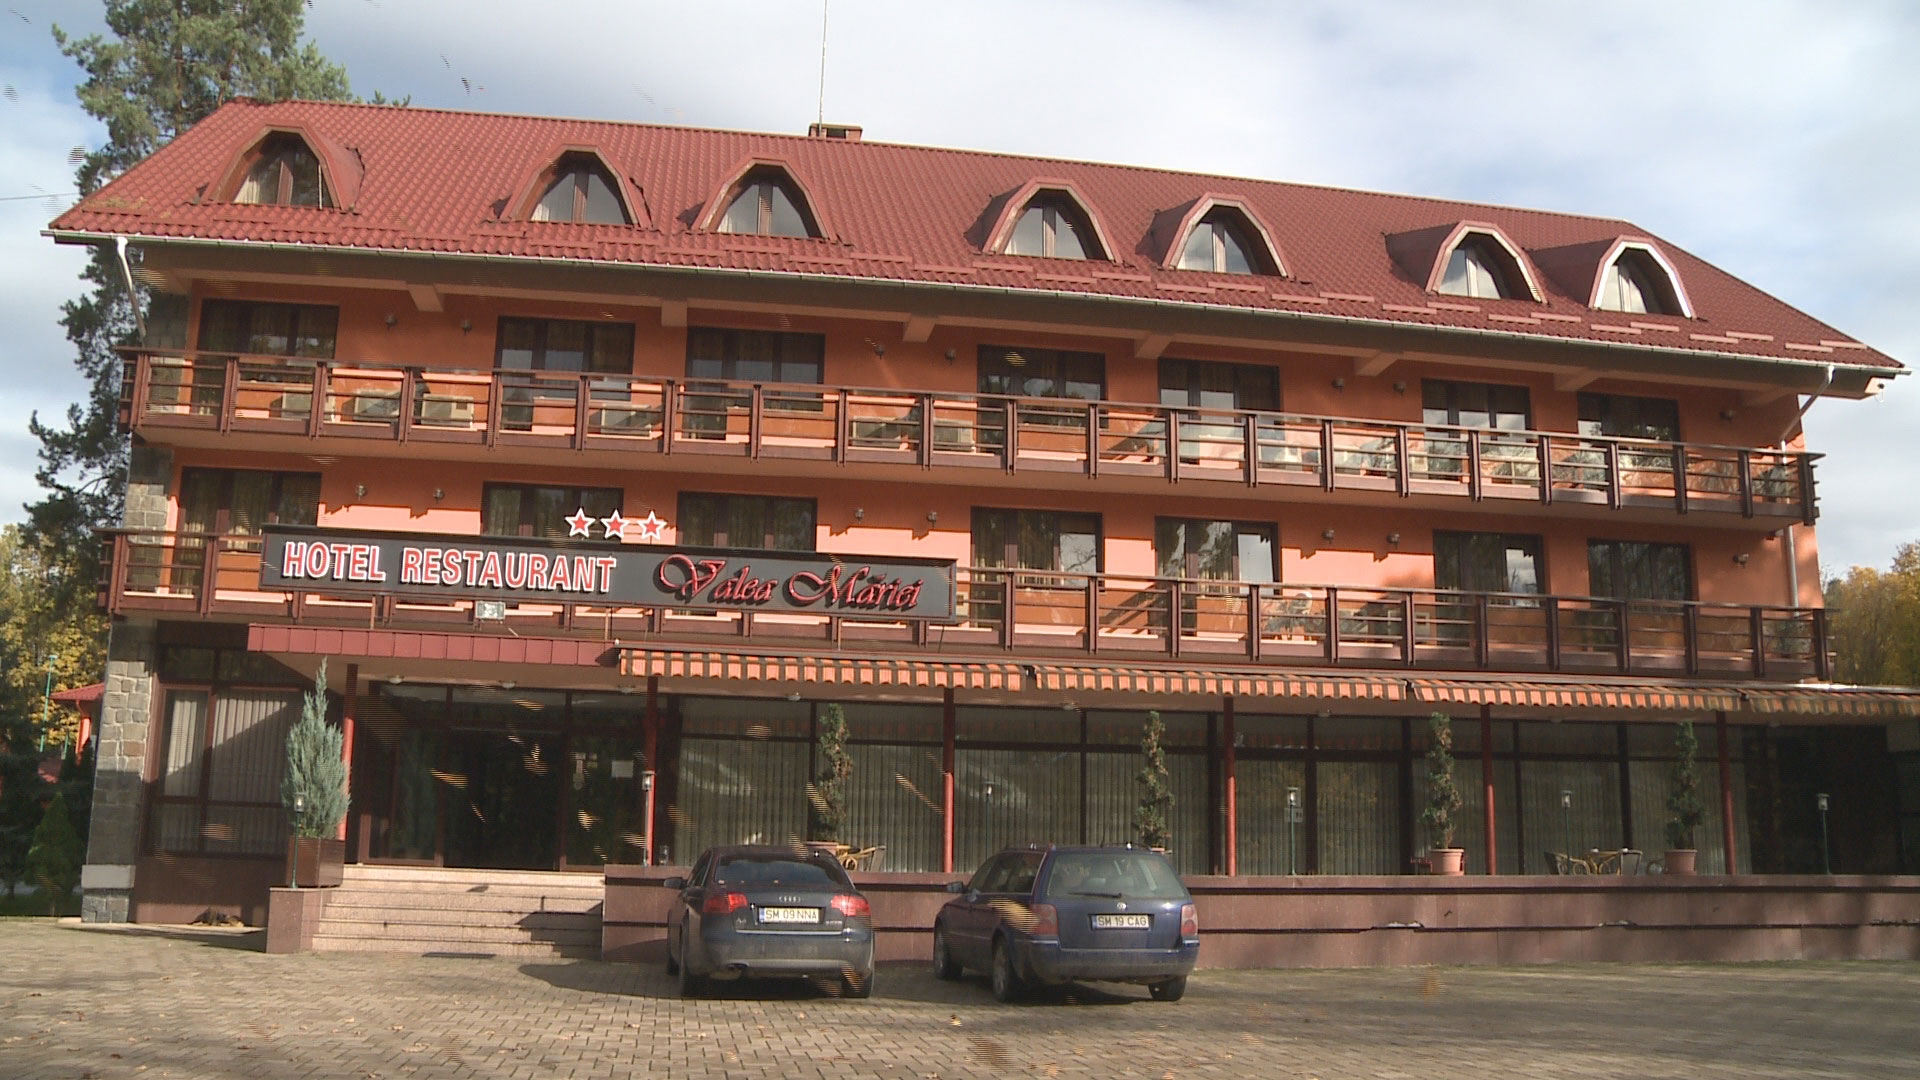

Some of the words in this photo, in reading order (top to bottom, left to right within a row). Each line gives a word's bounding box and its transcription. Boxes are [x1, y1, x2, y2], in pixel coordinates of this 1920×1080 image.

[282, 541, 386, 582] HOTEL
[401, 547, 616, 593] RESTAURANT
[659, 553, 778, 601] Valea
[765, 910, 779, 920] SM
[783, 910, 795, 920] 09
[796, 910, 817, 920] NNA
[1097, 915, 1112, 926] SM
[1114, 915, 1124, 926] 19
[1127, 915, 1147, 926] CAG
